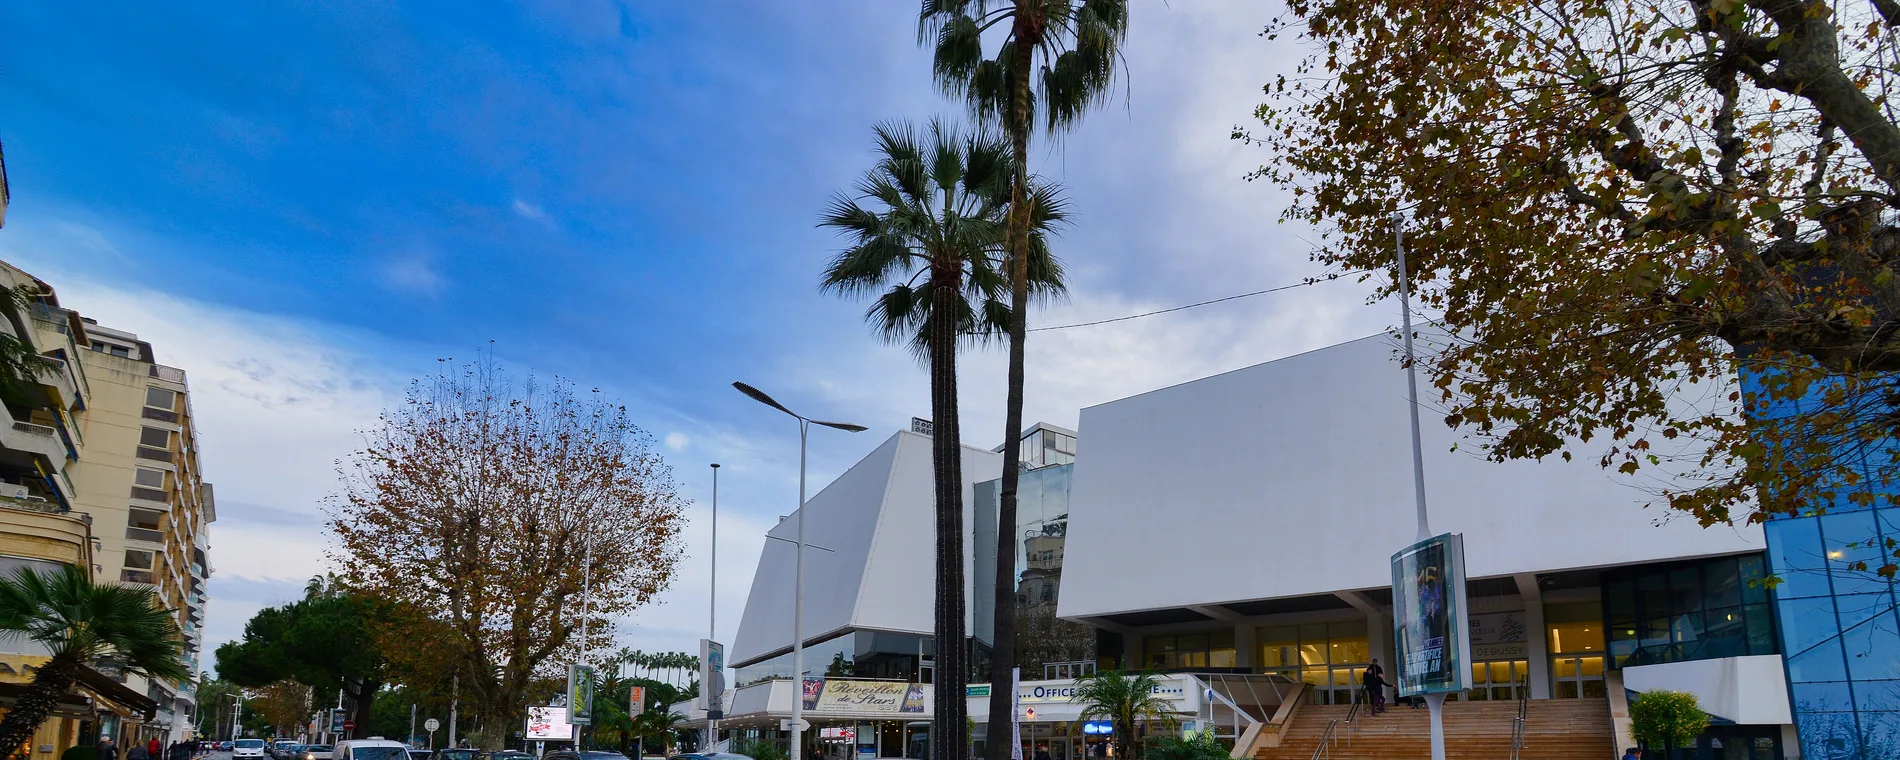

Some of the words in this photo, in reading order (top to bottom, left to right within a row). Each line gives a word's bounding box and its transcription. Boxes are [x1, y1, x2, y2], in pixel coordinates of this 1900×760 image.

[1476, 646, 1523, 657] DEBUSSY
[1430, 659, 1442, 672] AN
[829, 682, 903, 695] Réveillon
[837, 694, 851, 703] de
[852, 693, 896, 705] Stars
